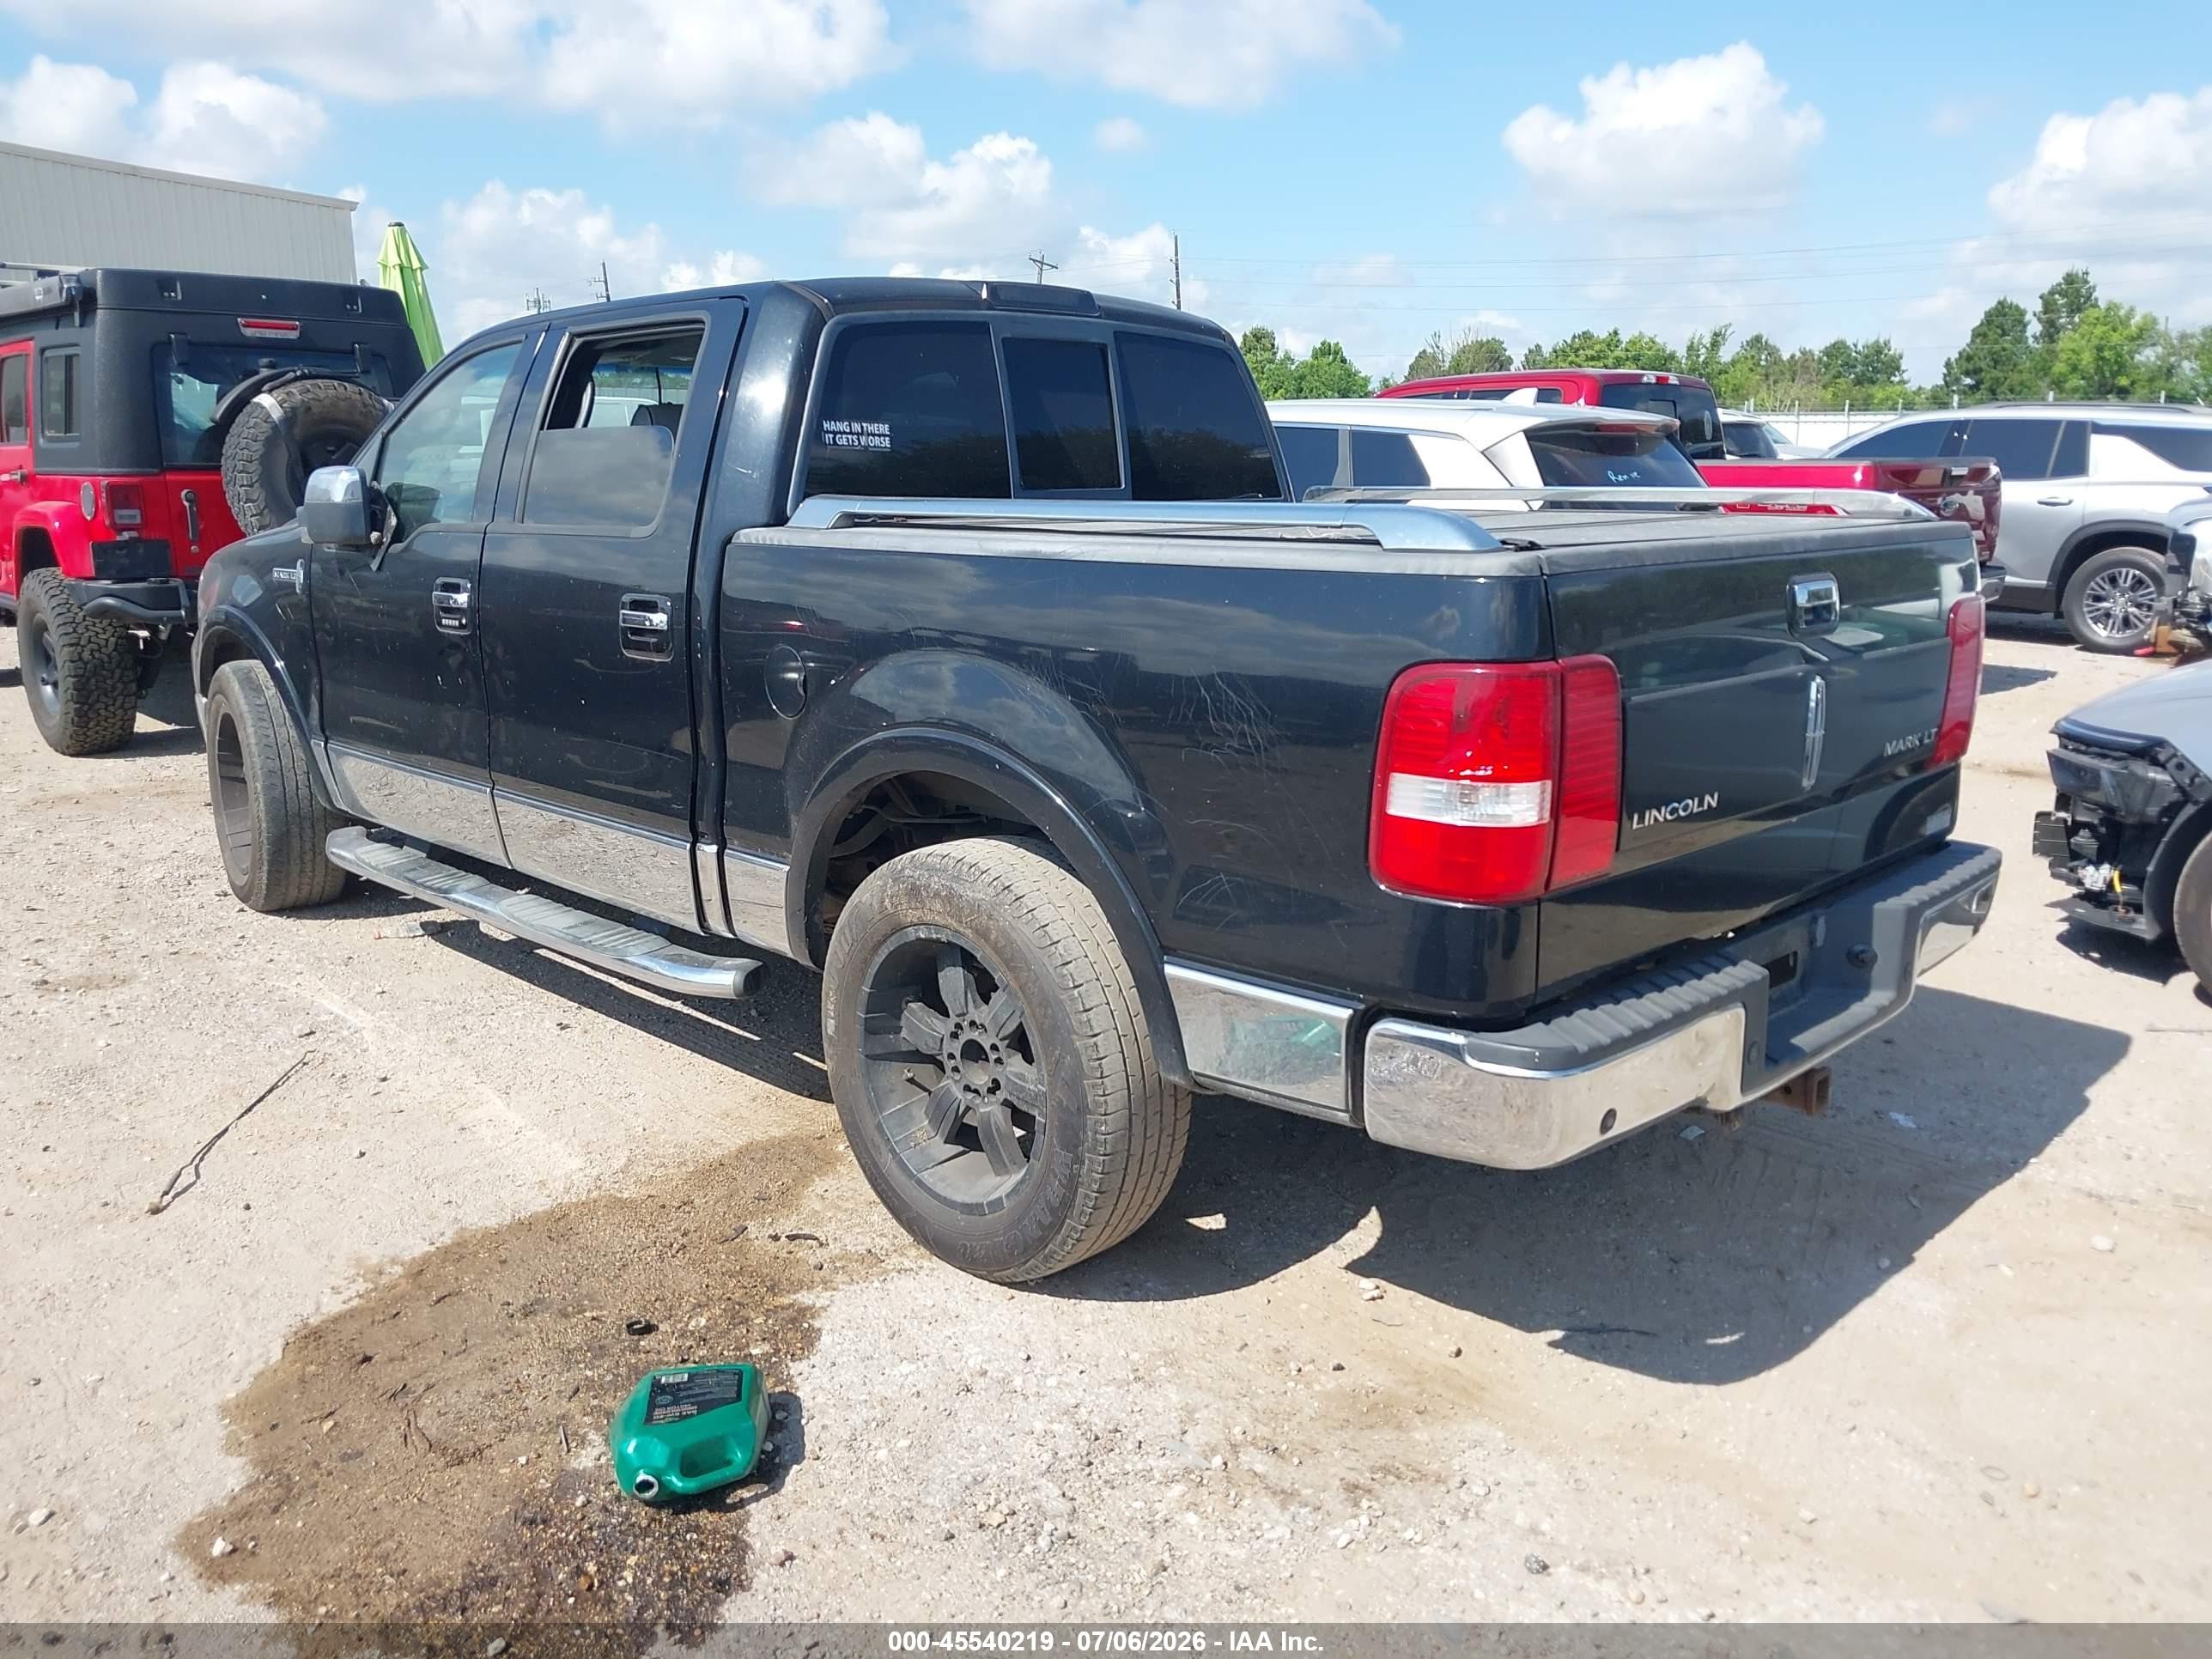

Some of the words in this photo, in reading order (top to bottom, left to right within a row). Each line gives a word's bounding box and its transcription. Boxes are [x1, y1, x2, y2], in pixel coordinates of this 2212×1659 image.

[823, 420, 850, 433] HANG
[851, 422, 861, 433] IN
[862, 422, 890, 435] THERE
[825, 434, 834, 445] IT
[836, 434, 859, 446] GETS
[860, 436, 891, 447] WORSE
[1883, 736, 1920, 757] MARK
[1923, 728, 1938, 744] LT
[1632, 792, 1719, 830] LINCOLN
